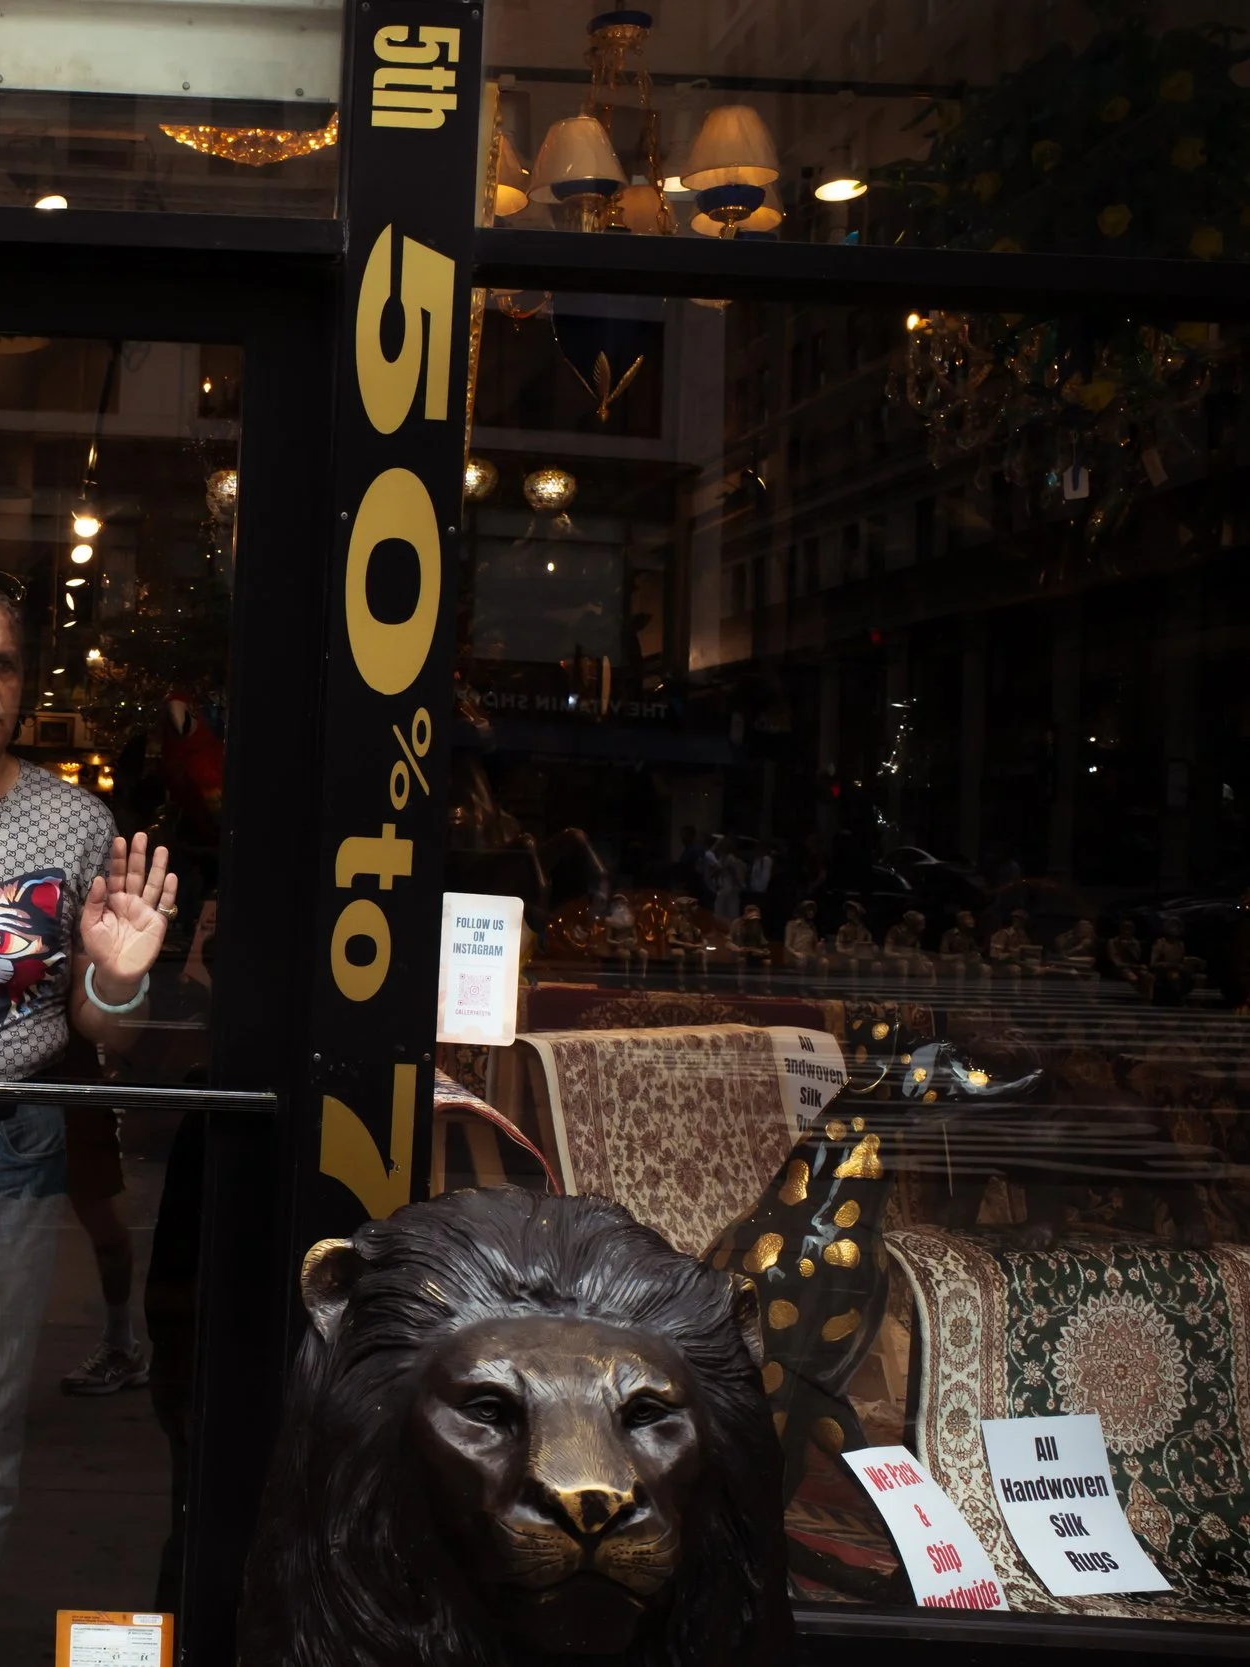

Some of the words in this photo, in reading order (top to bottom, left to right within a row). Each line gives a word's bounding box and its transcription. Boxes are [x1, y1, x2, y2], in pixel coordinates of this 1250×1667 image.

[370, 25, 461, 129] 5th
[330, 823, 414, 1002] to
[456, 917, 490, 930] FOLLOW
[492, 919, 504, 931] US
[473, 931, 485, 942] ON
[452, 942, 503, 957] INSTAGRAM
[798, 1035, 815, 1053] All
[800, 1086, 822, 1108] Silk
[1035, 1436, 1059, 1461] All
[864, 1463, 894, 1491] We
[886, 1461, 924, 1487] Pack
[1000, 1475, 1109, 1503] Handwoven
[914, 1504, 932, 1527] &
[1049, 1512, 1090, 1538] Silk
[926, 1541, 962, 1574] Ship
[1064, 1550, 1120, 1573] Rugs
